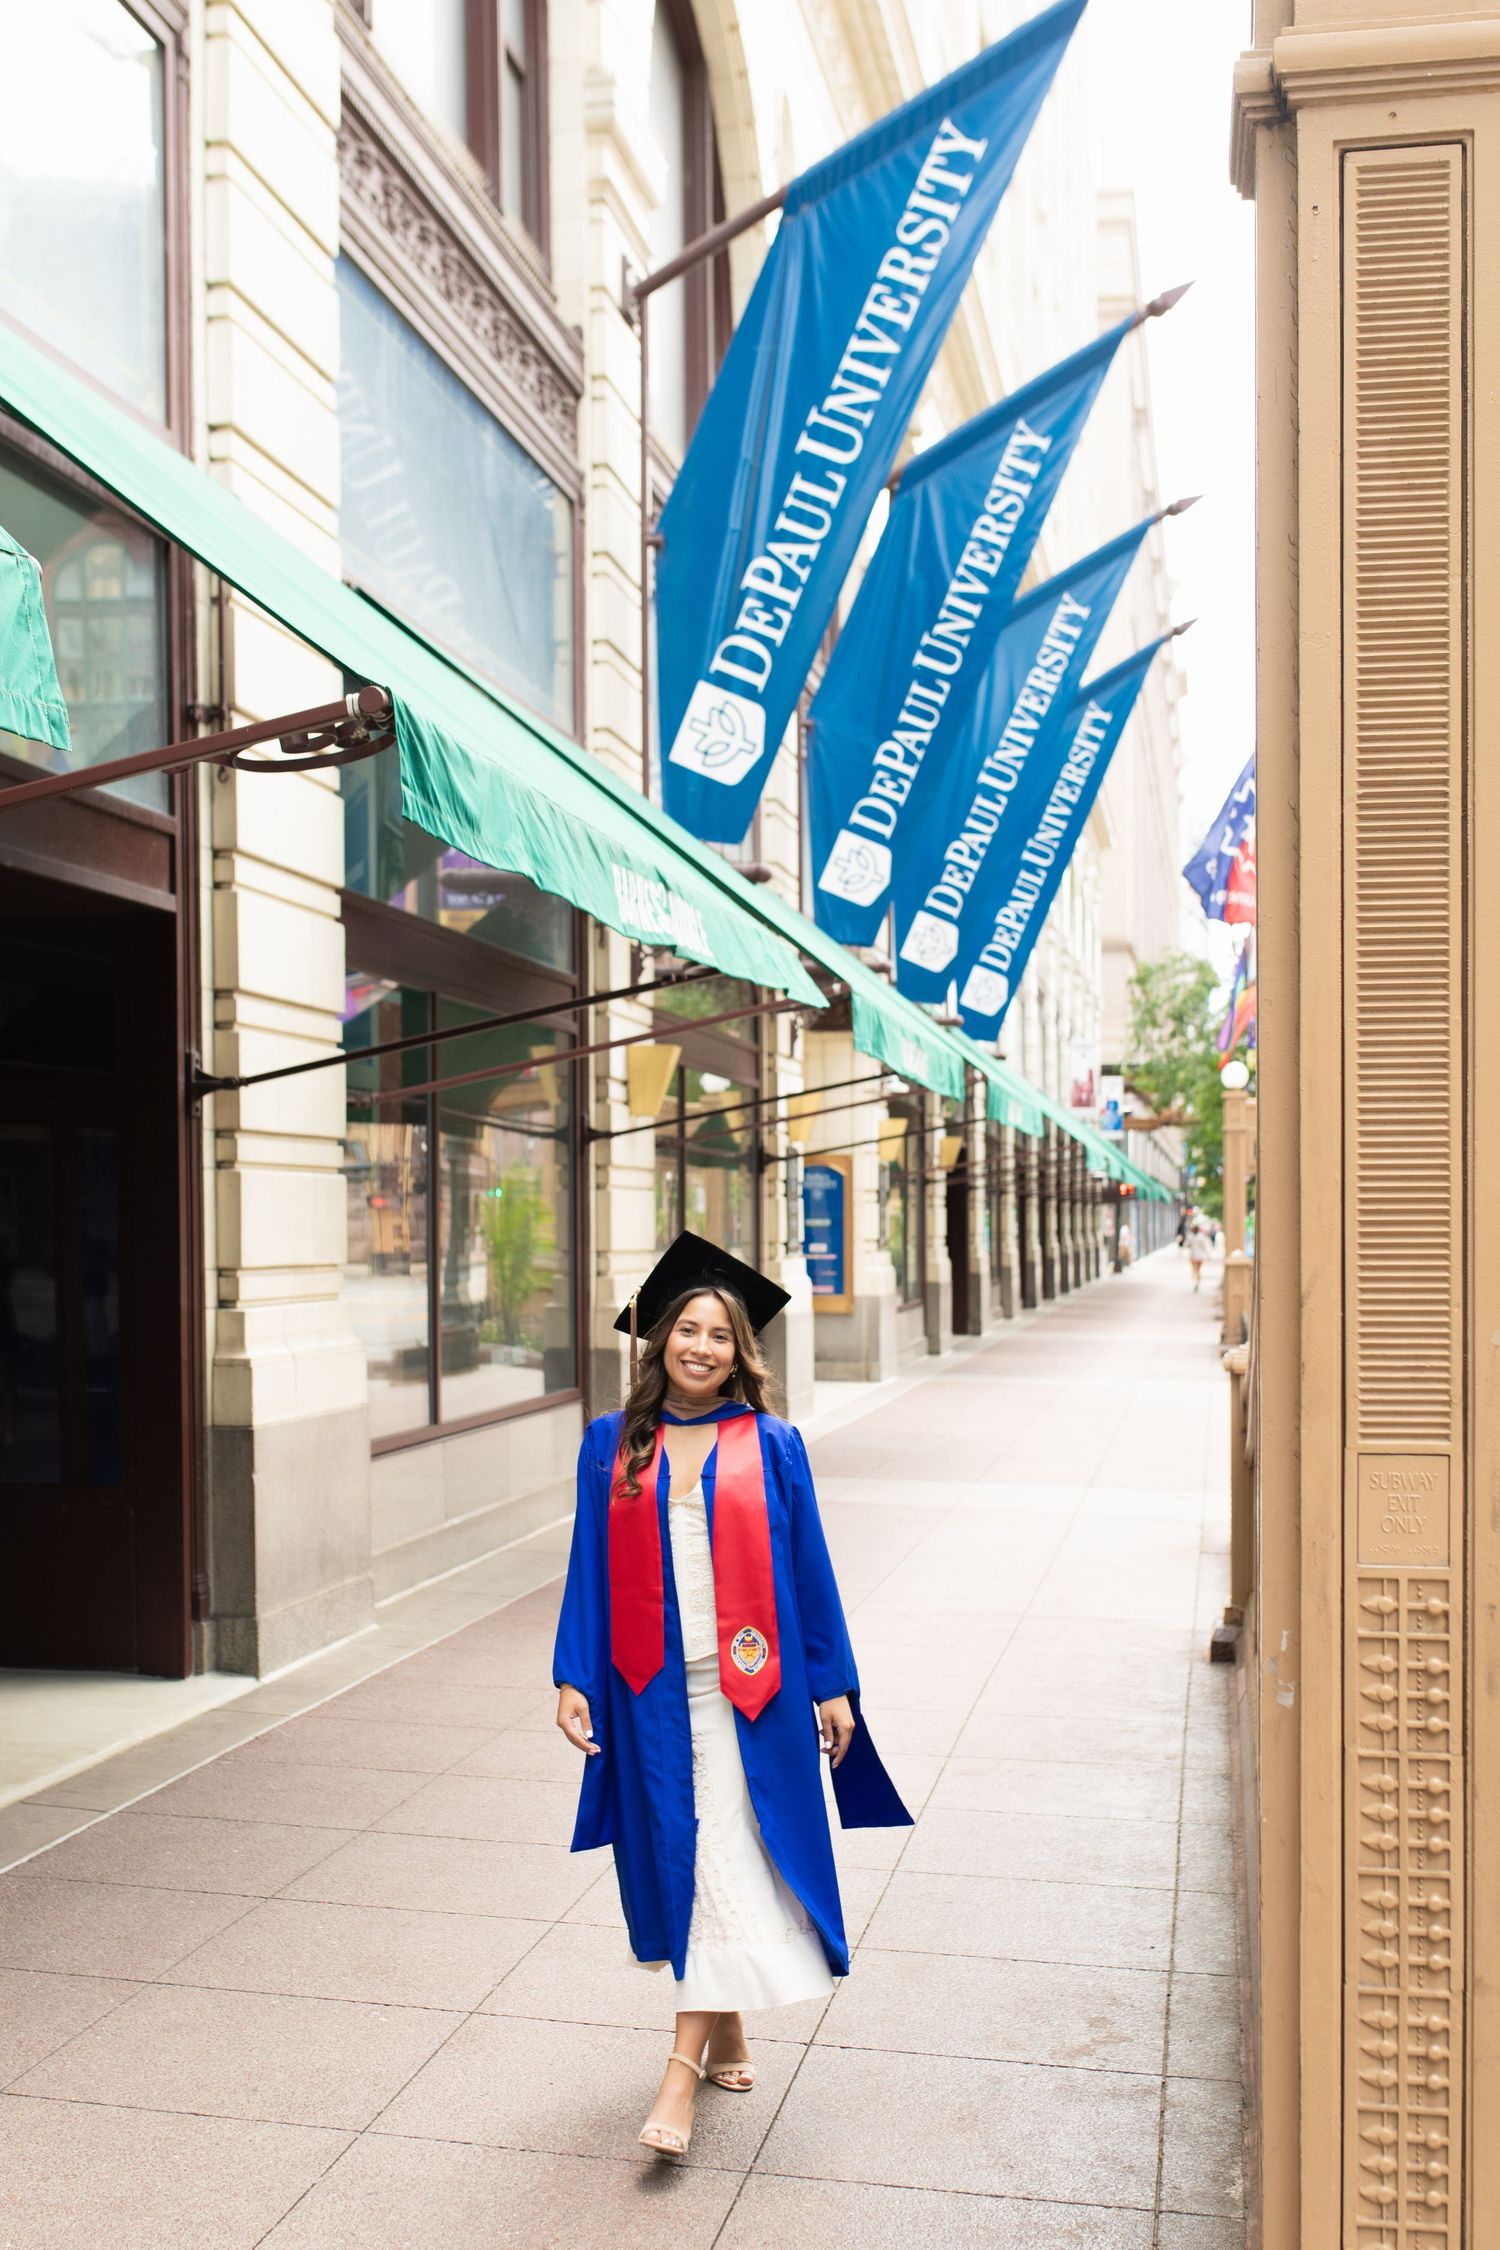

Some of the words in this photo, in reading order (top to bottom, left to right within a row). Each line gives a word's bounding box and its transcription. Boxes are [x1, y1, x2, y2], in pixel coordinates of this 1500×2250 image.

[795, 118, 988, 464] UNIVERSITY
[914, 418, 1051, 676] UNIVERSITY
[978, 592, 1091, 792] UNIVERSITY
[1022, 700, 1112, 866] UNIVERSITY
[1369, 1472, 1438, 1491] SUBWAY
[1380, 1515, 1427, 1534] ONLY
[1387, 1493, 1421, 1513] EXIT
